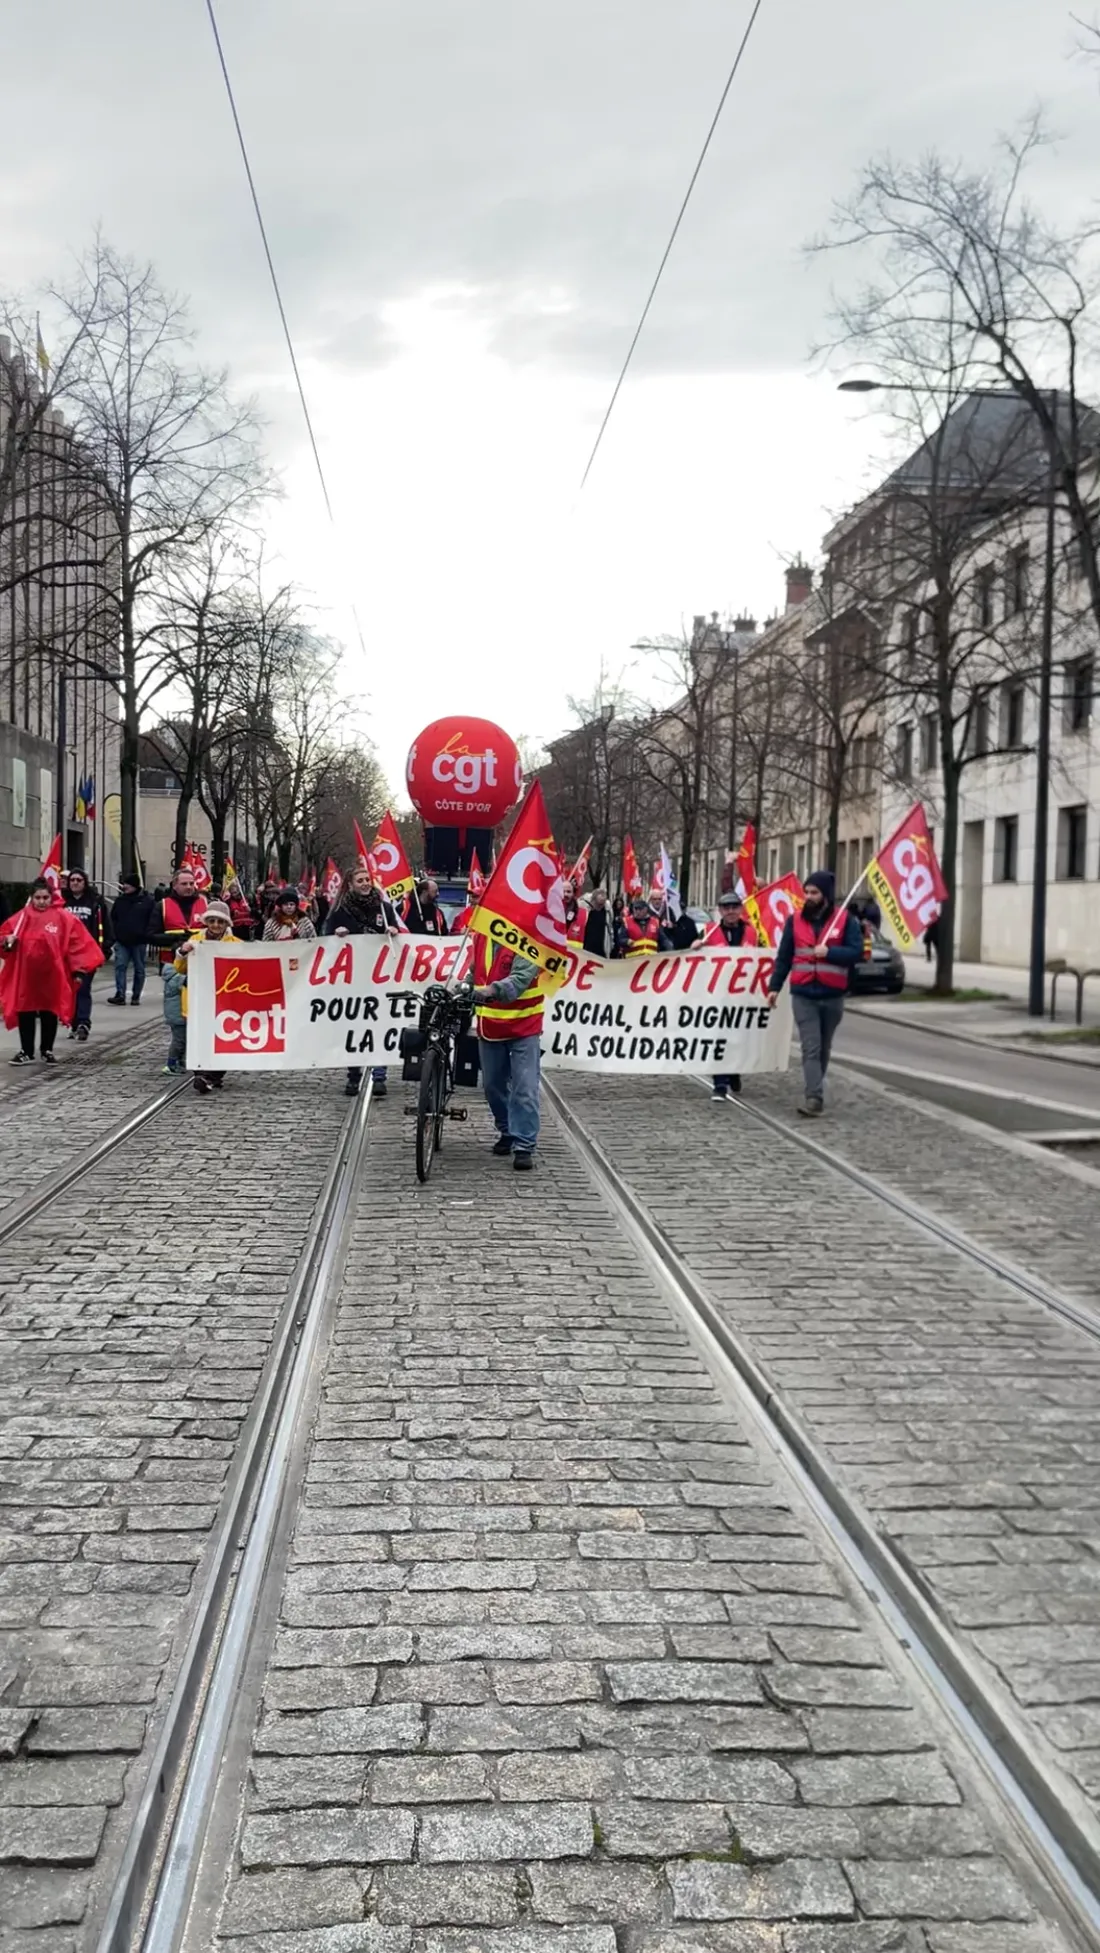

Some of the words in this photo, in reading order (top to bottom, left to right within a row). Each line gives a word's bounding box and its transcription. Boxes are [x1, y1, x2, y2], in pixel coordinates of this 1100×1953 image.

[436, 731, 496, 758] la
[431, 748, 498, 795] cgt
[434, 798, 463, 812] CÔTE
[466, 801, 492, 813] D'OR
[506, 846, 567, 946] cg
[871, 870, 911, 945] NEXTROAD
[489, 919, 540, 960] Côte
[215, 966, 282, 996] la
[308, 942, 354, 986] LA
[630, 955, 775, 998] LUTTER
[214, 1003, 287, 1051] cgt
[310, 995, 380, 1023] POUR
[551, 999, 633, 1034] SOCIAL,
[639, 1005, 668, 1029] LA
[677, 1004, 771, 1030] DIGNITE
[345, 1029, 375, 1053] LA
[551, 1031, 578, 1057] LA
[586, 1034, 728, 1063] SOLIDARITE
